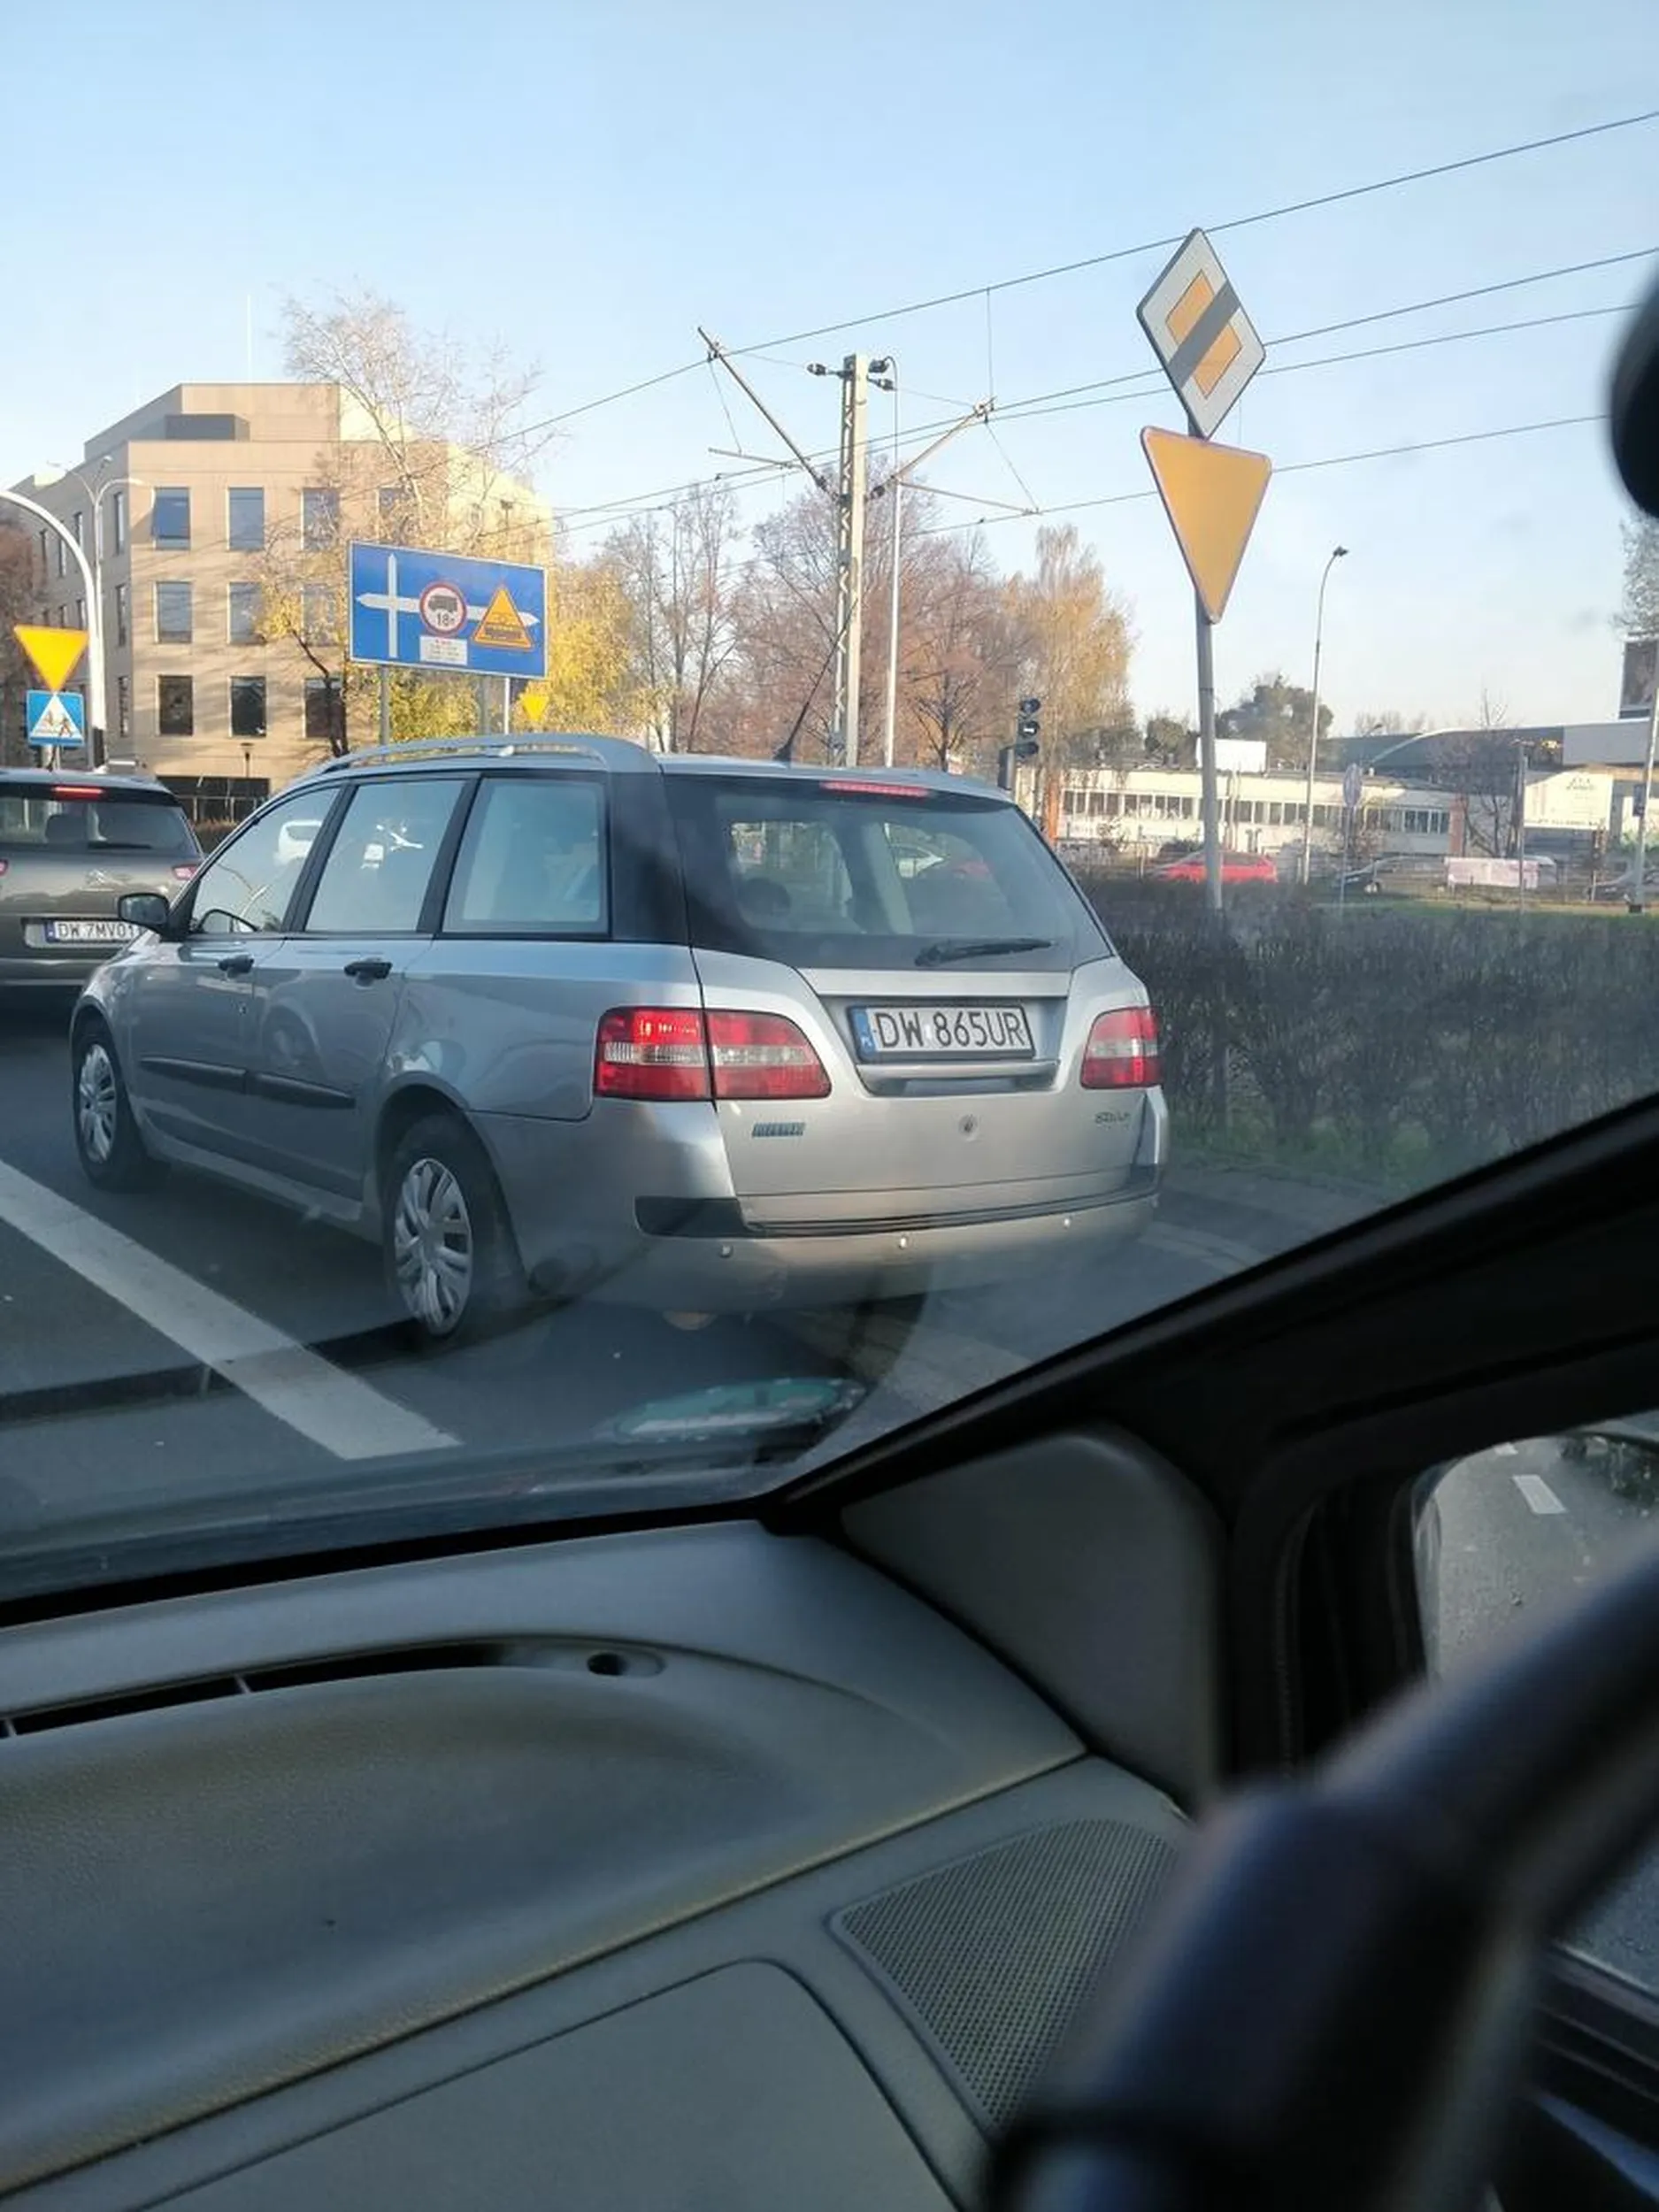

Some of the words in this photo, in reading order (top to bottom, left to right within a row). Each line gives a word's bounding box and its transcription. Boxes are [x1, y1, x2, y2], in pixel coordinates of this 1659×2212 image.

[58, 923, 81, 938] DW
[874, 1011, 924, 1048] DW
[933, 1011, 1025, 1048] 865UR
